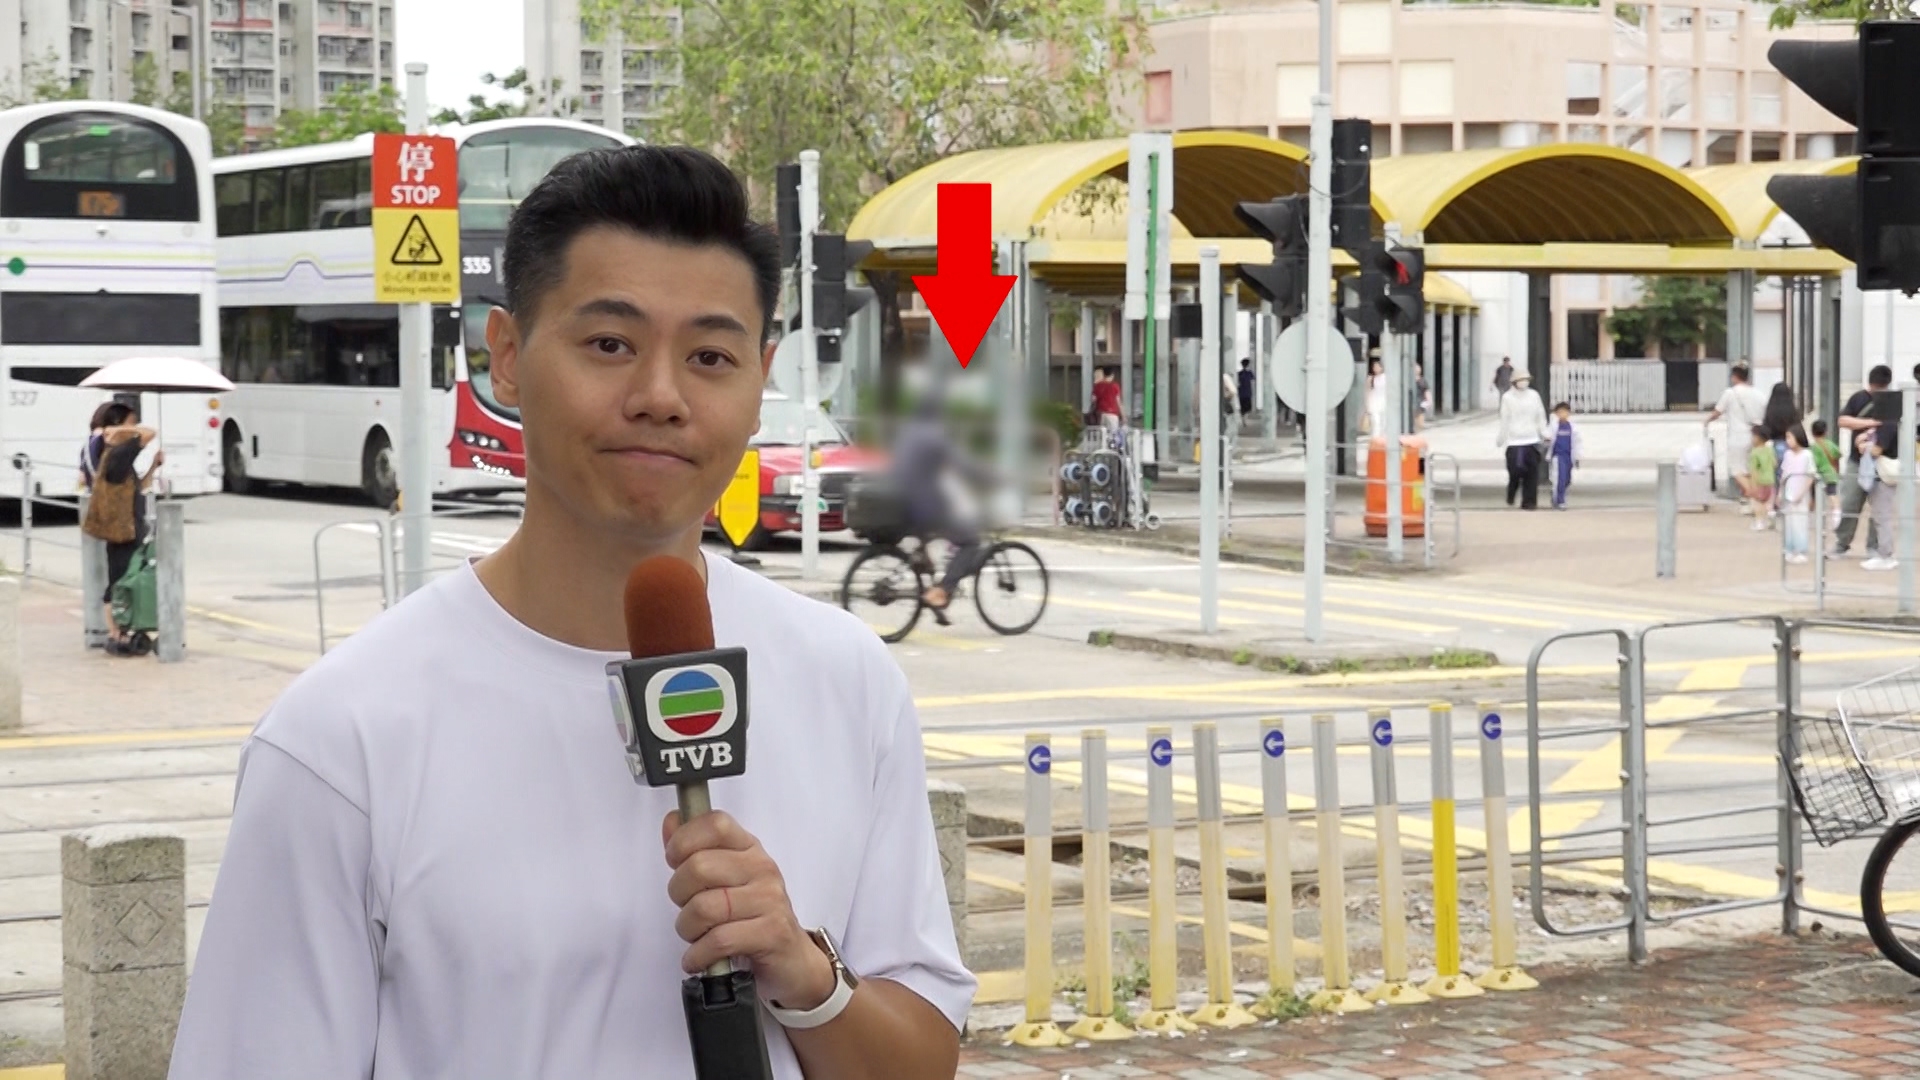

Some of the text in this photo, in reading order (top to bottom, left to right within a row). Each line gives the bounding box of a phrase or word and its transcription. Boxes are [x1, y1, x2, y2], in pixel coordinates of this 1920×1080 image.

[398, 142, 434, 182] 停
[391, 185, 441, 204] STOP
[462, 256, 492, 274] 335
[660, 741, 733, 774] TVB
